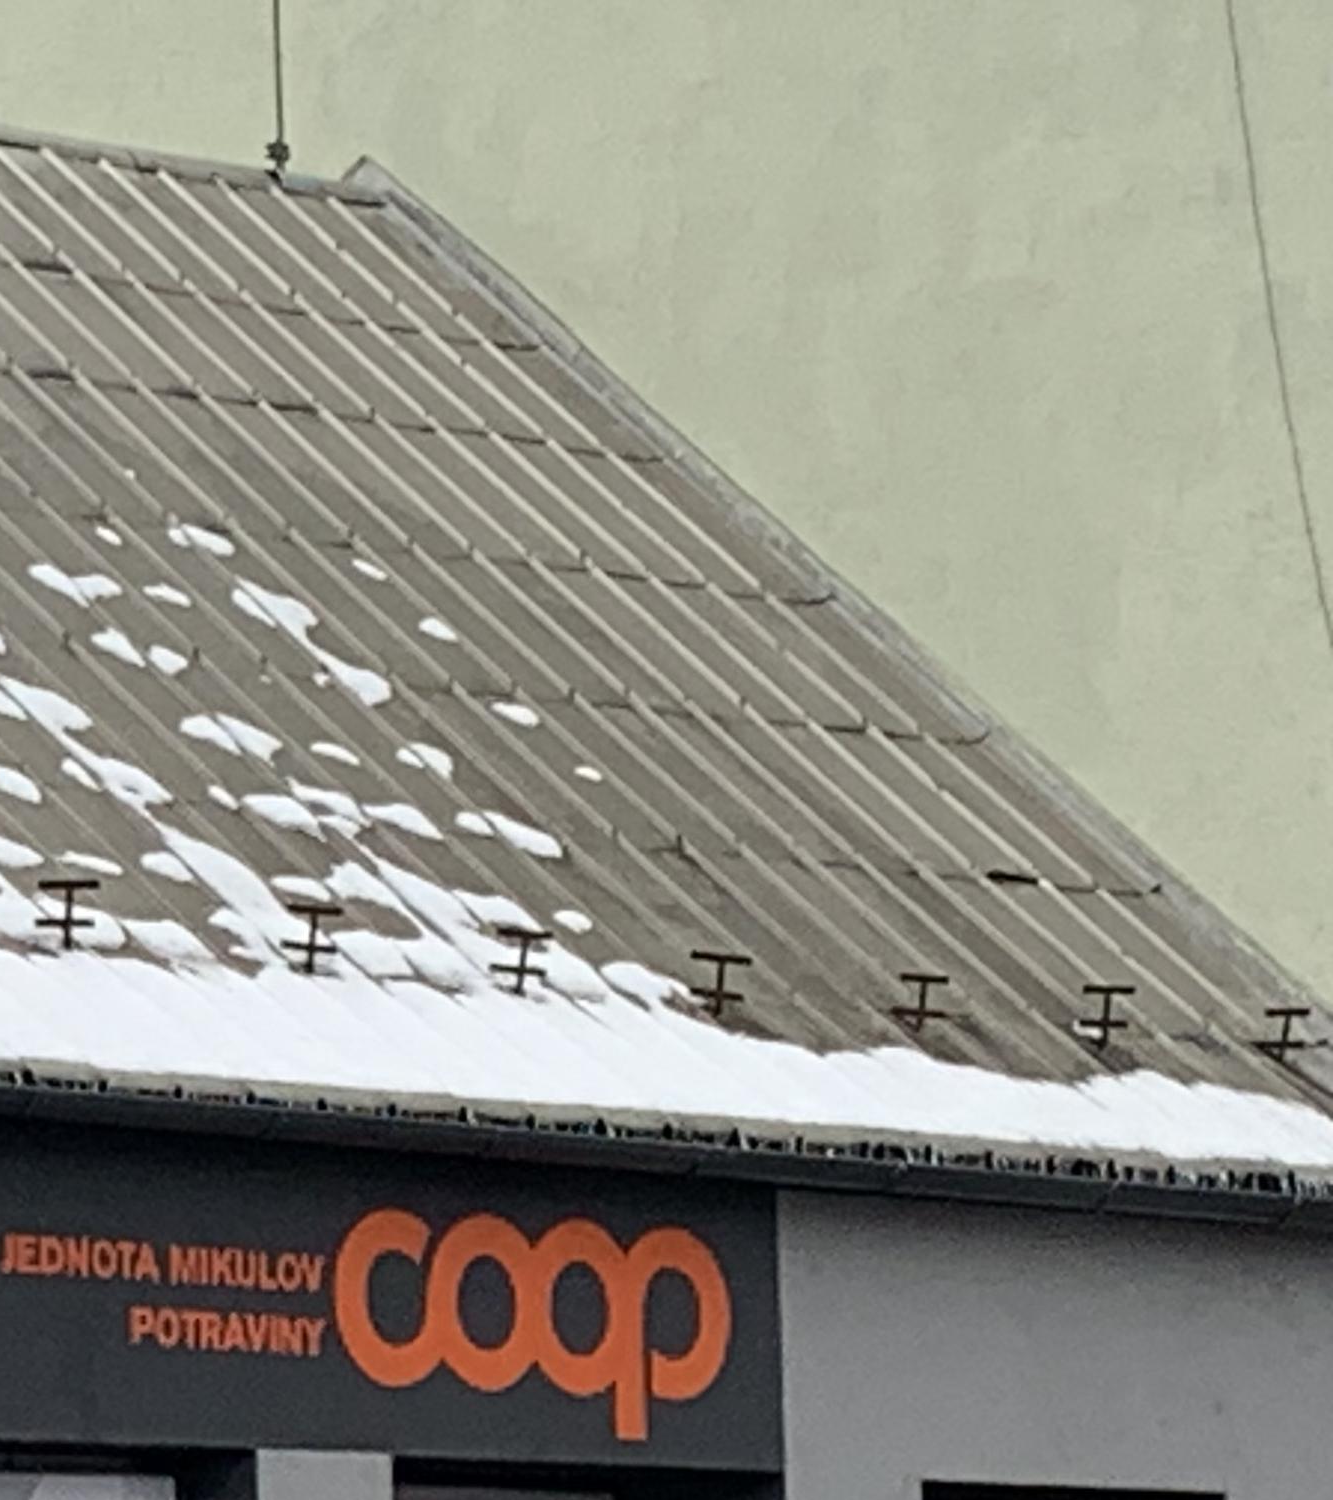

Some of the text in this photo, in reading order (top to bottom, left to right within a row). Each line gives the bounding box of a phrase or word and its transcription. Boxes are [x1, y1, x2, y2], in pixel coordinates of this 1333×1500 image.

[0, 1232, 325, 1292] JEDNOTA MIKULOV
[130, 1305, 325, 1356] POTRAVINY
